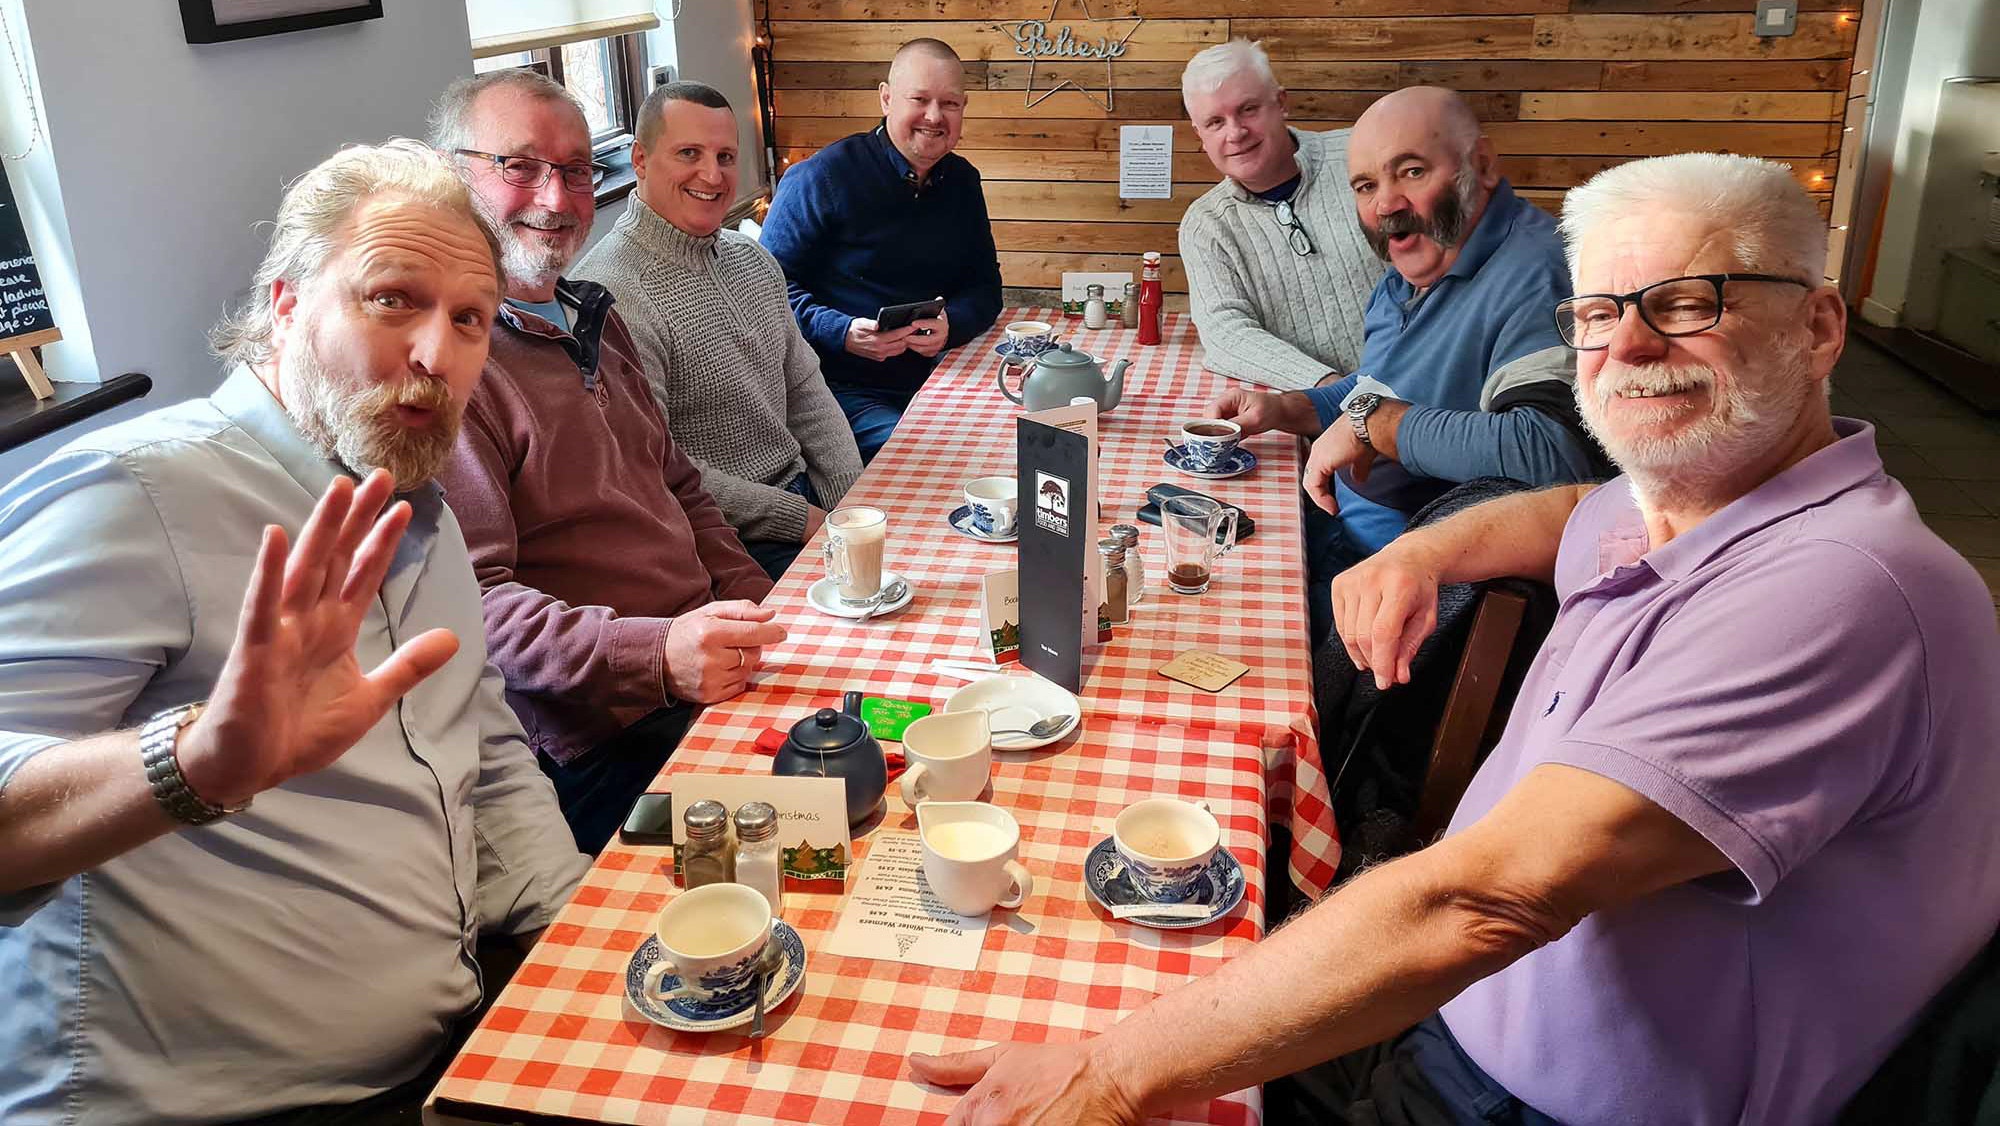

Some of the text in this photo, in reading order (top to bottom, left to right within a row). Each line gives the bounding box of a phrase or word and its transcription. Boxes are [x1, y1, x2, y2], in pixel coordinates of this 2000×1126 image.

[1015, 20, 1126, 58] Believe
[1037, 507, 1068, 527] timbers
[859, 919, 896, 928] Warmers
